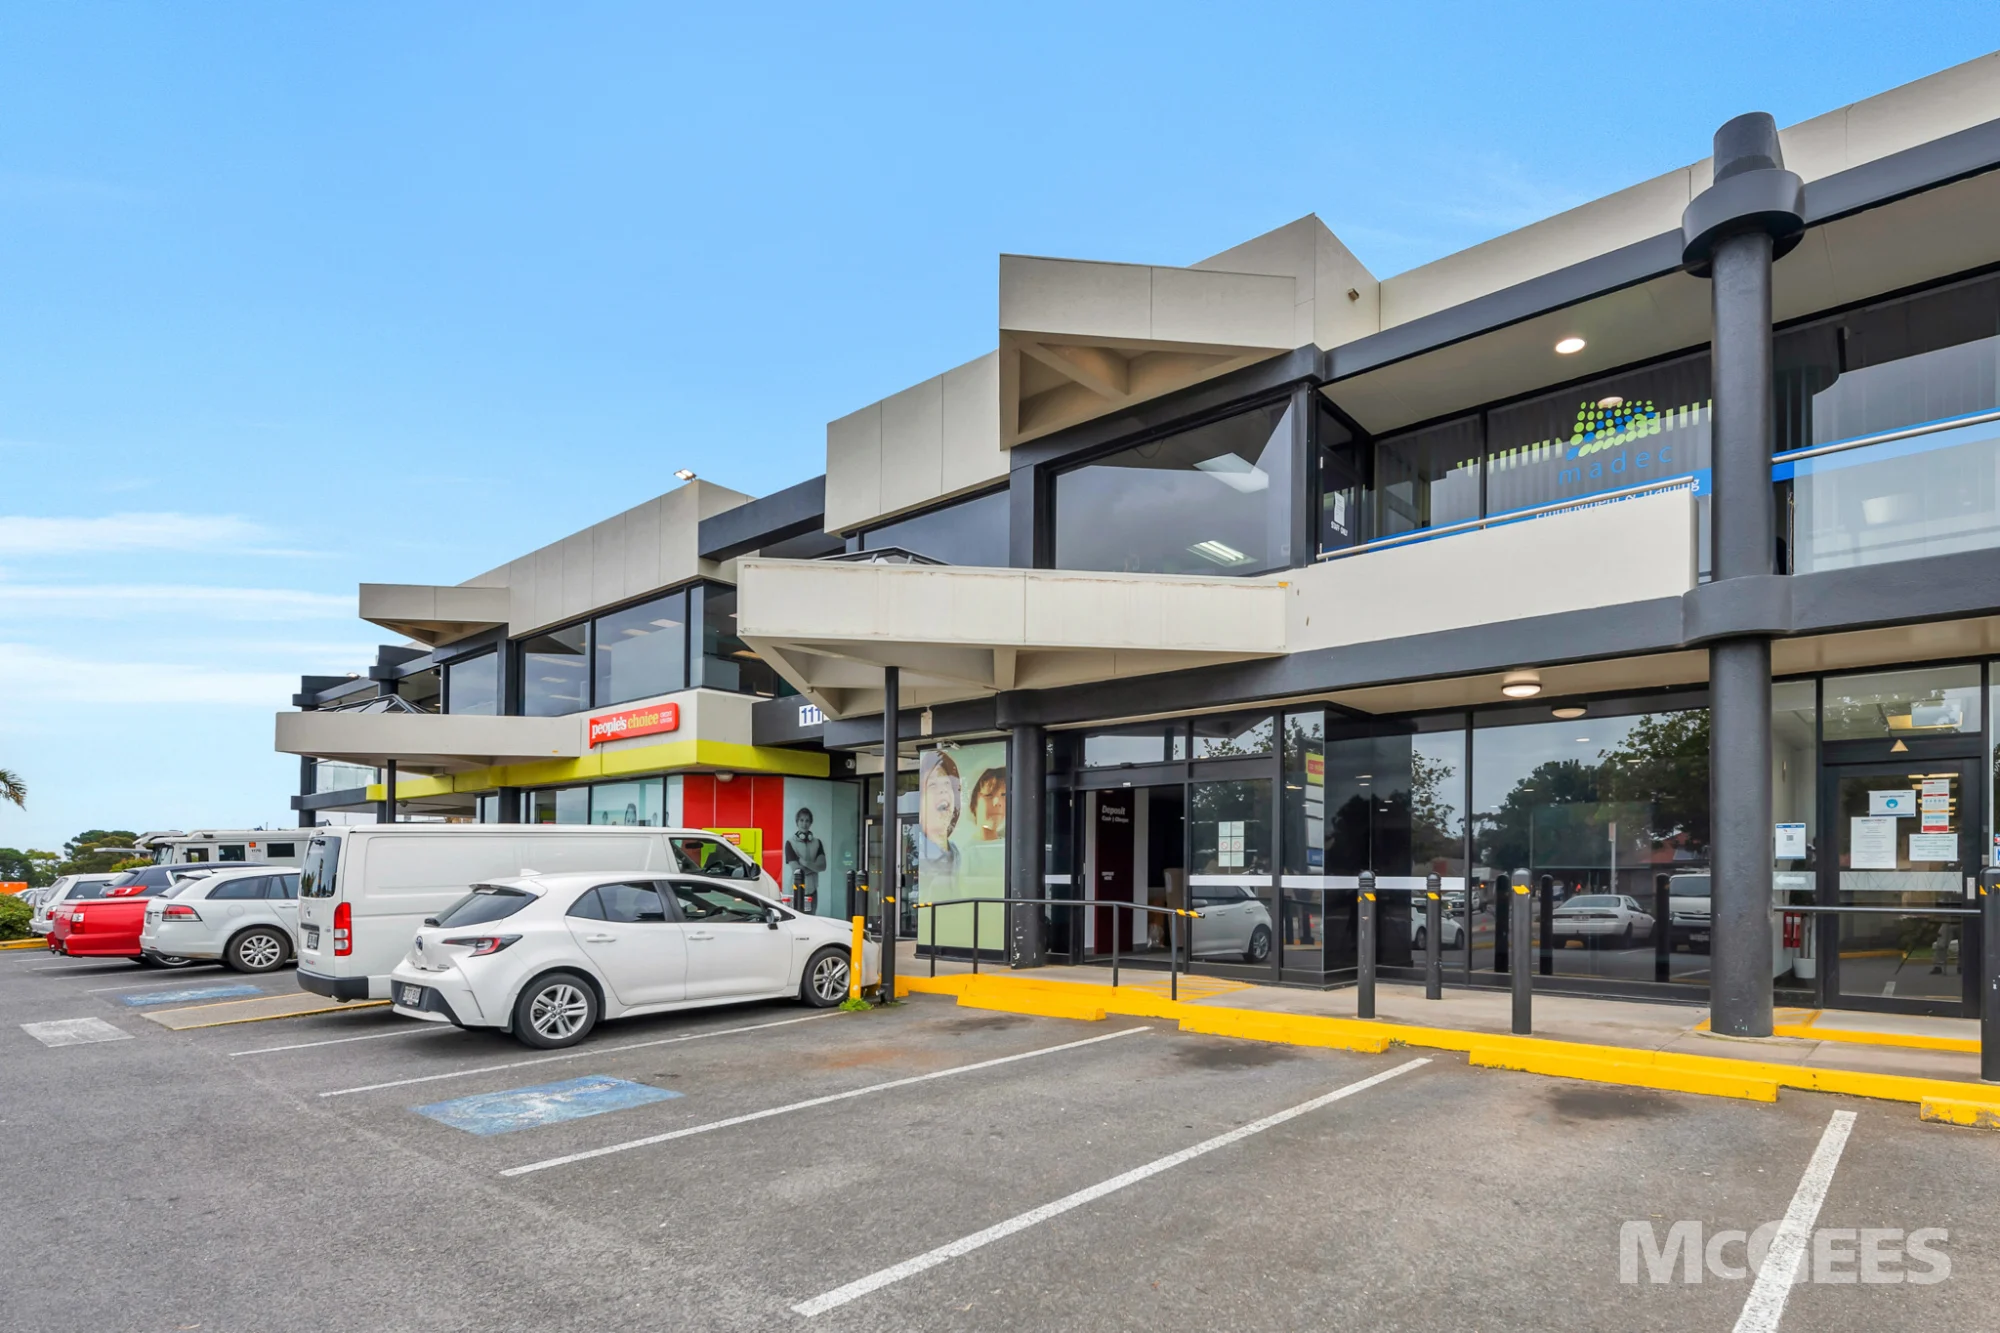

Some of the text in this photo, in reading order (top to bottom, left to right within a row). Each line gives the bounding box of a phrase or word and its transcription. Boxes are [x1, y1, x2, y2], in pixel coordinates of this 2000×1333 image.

[1558, 446, 1673, 485] madec
[591, 711, 659, 739] people's choice
[801, 706, 821, 724] 111
[1102, 805, 1125, 815] Deposit
